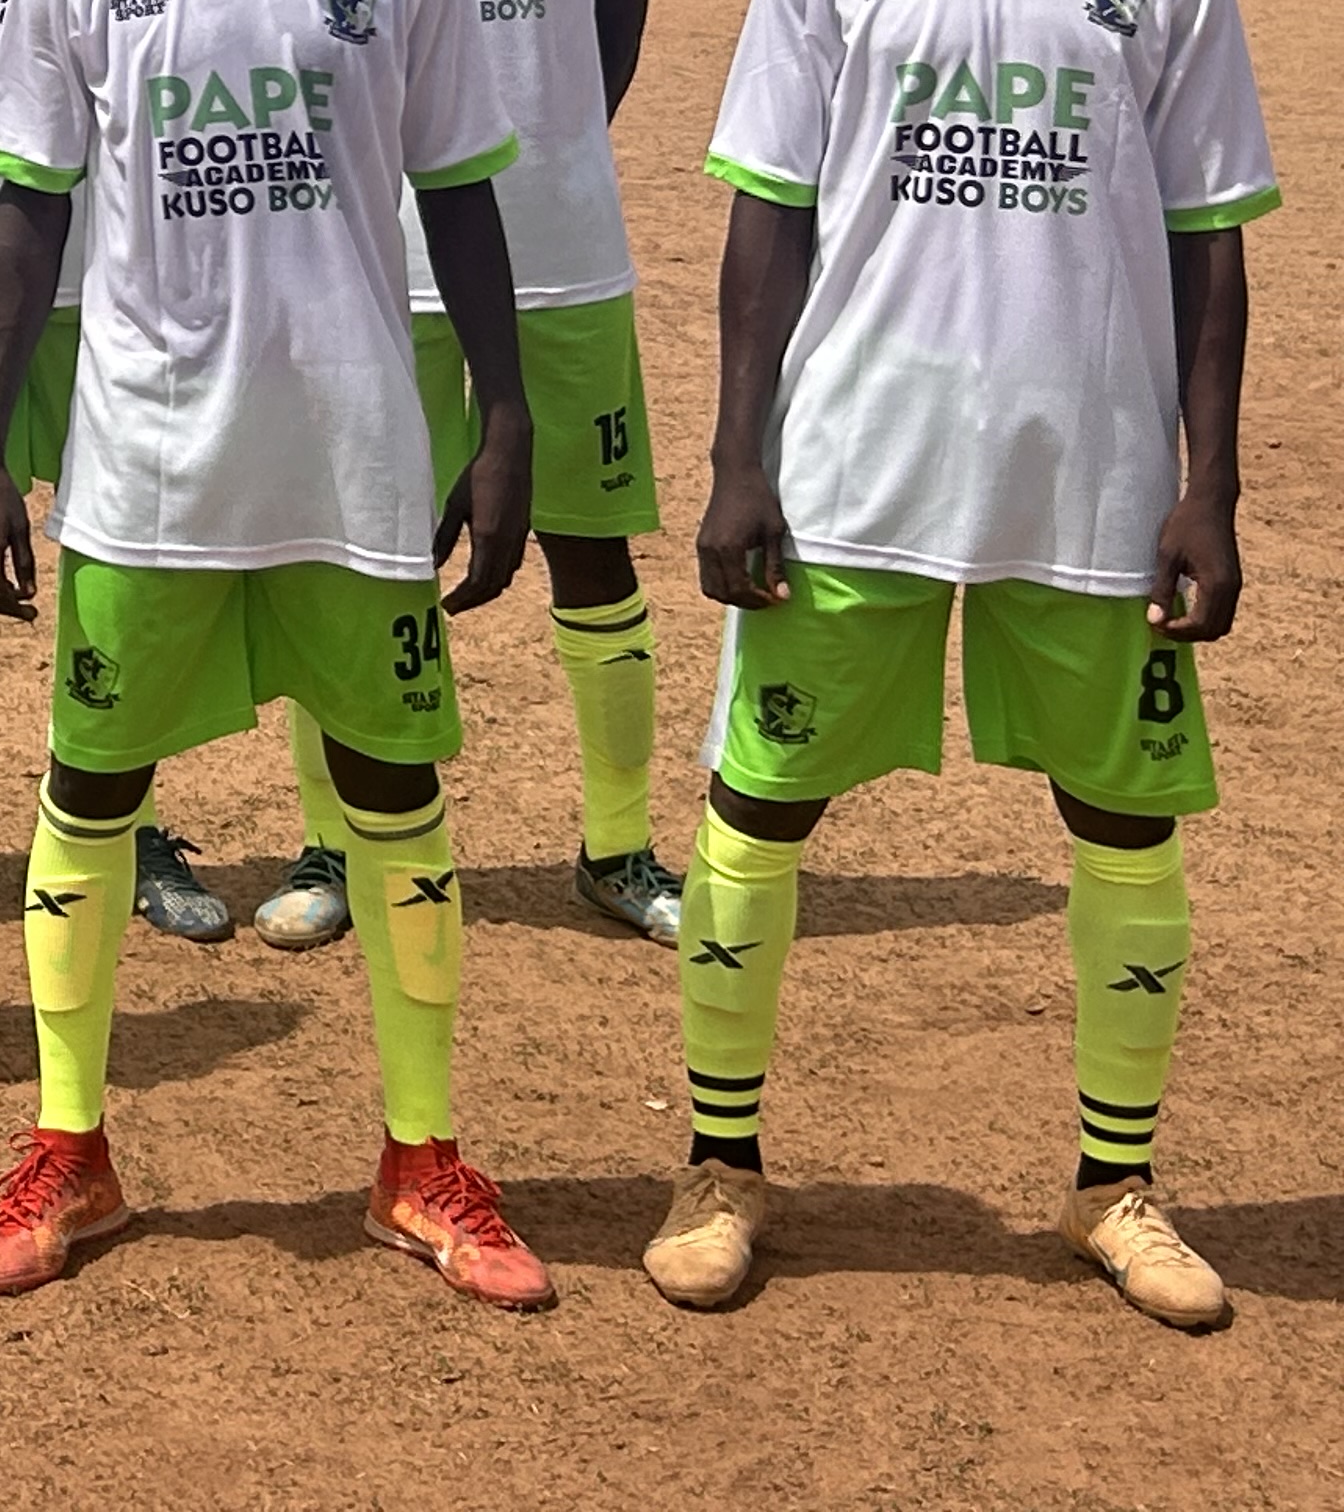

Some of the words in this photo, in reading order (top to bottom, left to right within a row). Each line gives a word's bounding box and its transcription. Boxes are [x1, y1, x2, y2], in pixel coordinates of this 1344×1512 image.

[147, 66, 334, 138] PAPE
[890, 59, 1095, 130] PAPE
[158, 130, 324, 169] FOOTBAL
[895, 123, 1088, 163] FOOTBALL
[185, 161, 327, 187] ACADEMY
[918, 154, 1064, 182] ACADEMY
[162, 187, 255, 219] KUSO
[268, 183, 333, 211] BOY
[891, 175, 985, 207] KUSO
[999, 182, 1088, 215] BOYS
[594, 406, 628, 465] 15
[392, 605, 441, 680] 34
[1137, 649, 1184, 723] 8
